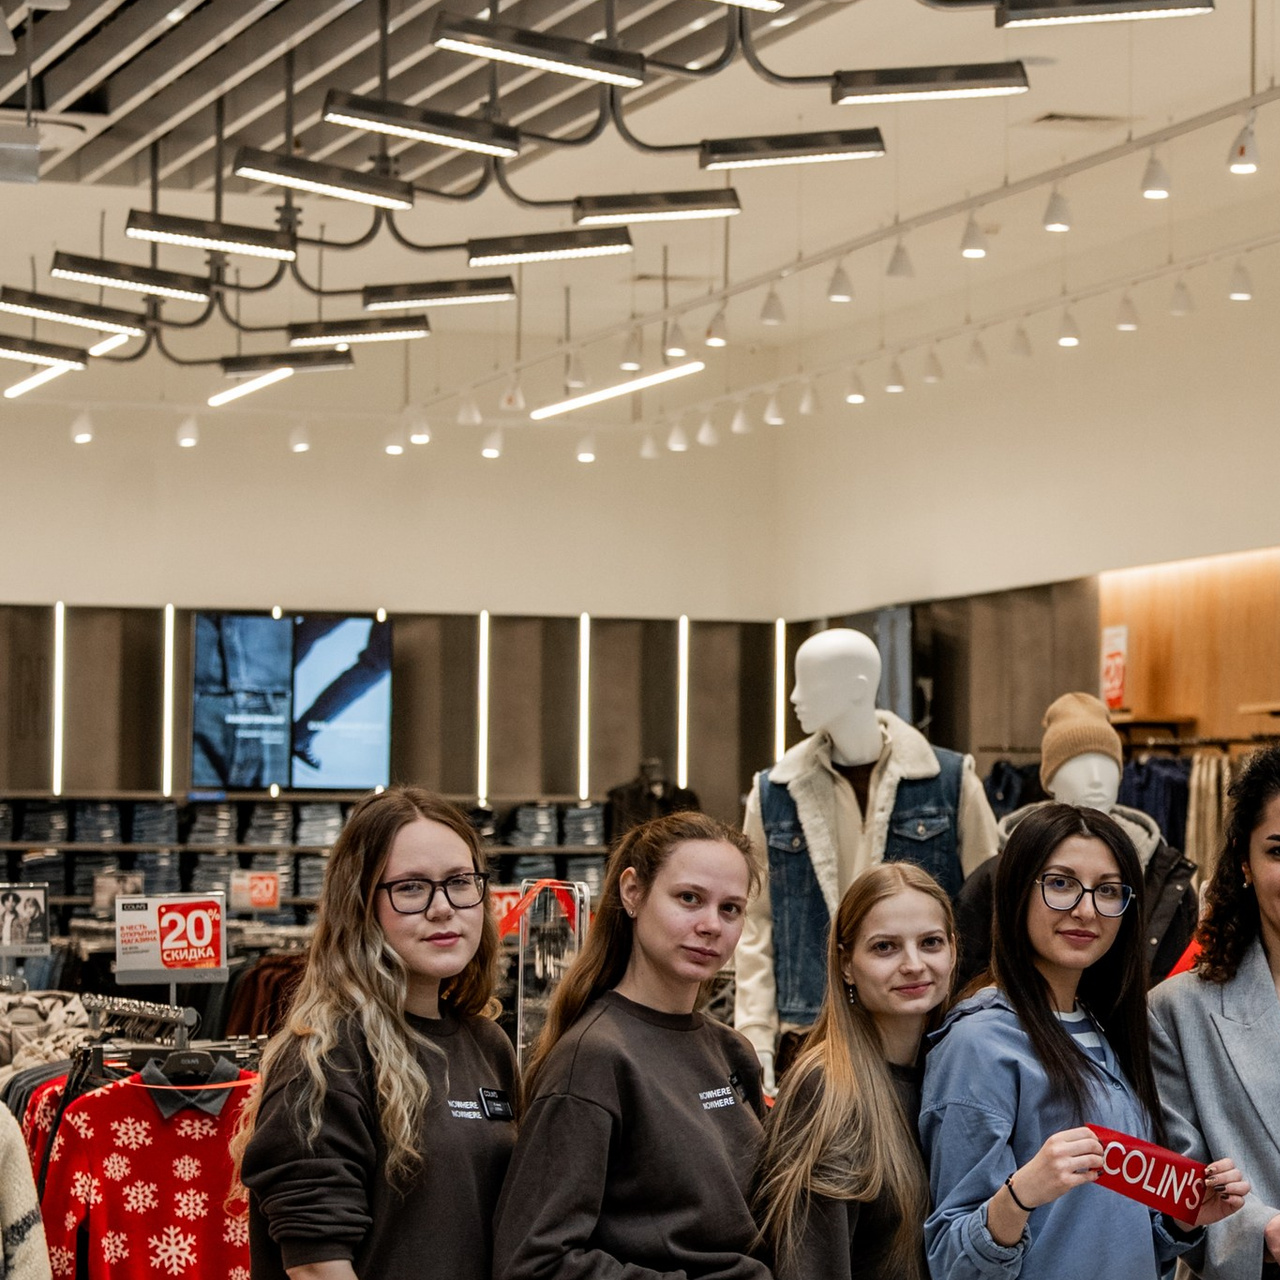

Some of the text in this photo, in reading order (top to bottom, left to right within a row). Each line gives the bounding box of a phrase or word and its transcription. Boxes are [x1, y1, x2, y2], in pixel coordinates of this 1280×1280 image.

[121, 936, 157, 945] МАГАЗИНА
[162, 947, 215, 962] СКИДКА
[698, 1086, 732, 1100] NOWHERE
[447, 1100, 479, 1110] NOWHERE
[702, 1096, 735, 1110] NOWHERE
[451, 1109, 483, 1119] NOWHERE
[1102, 1141, 1204, 1210] COLIN'S
